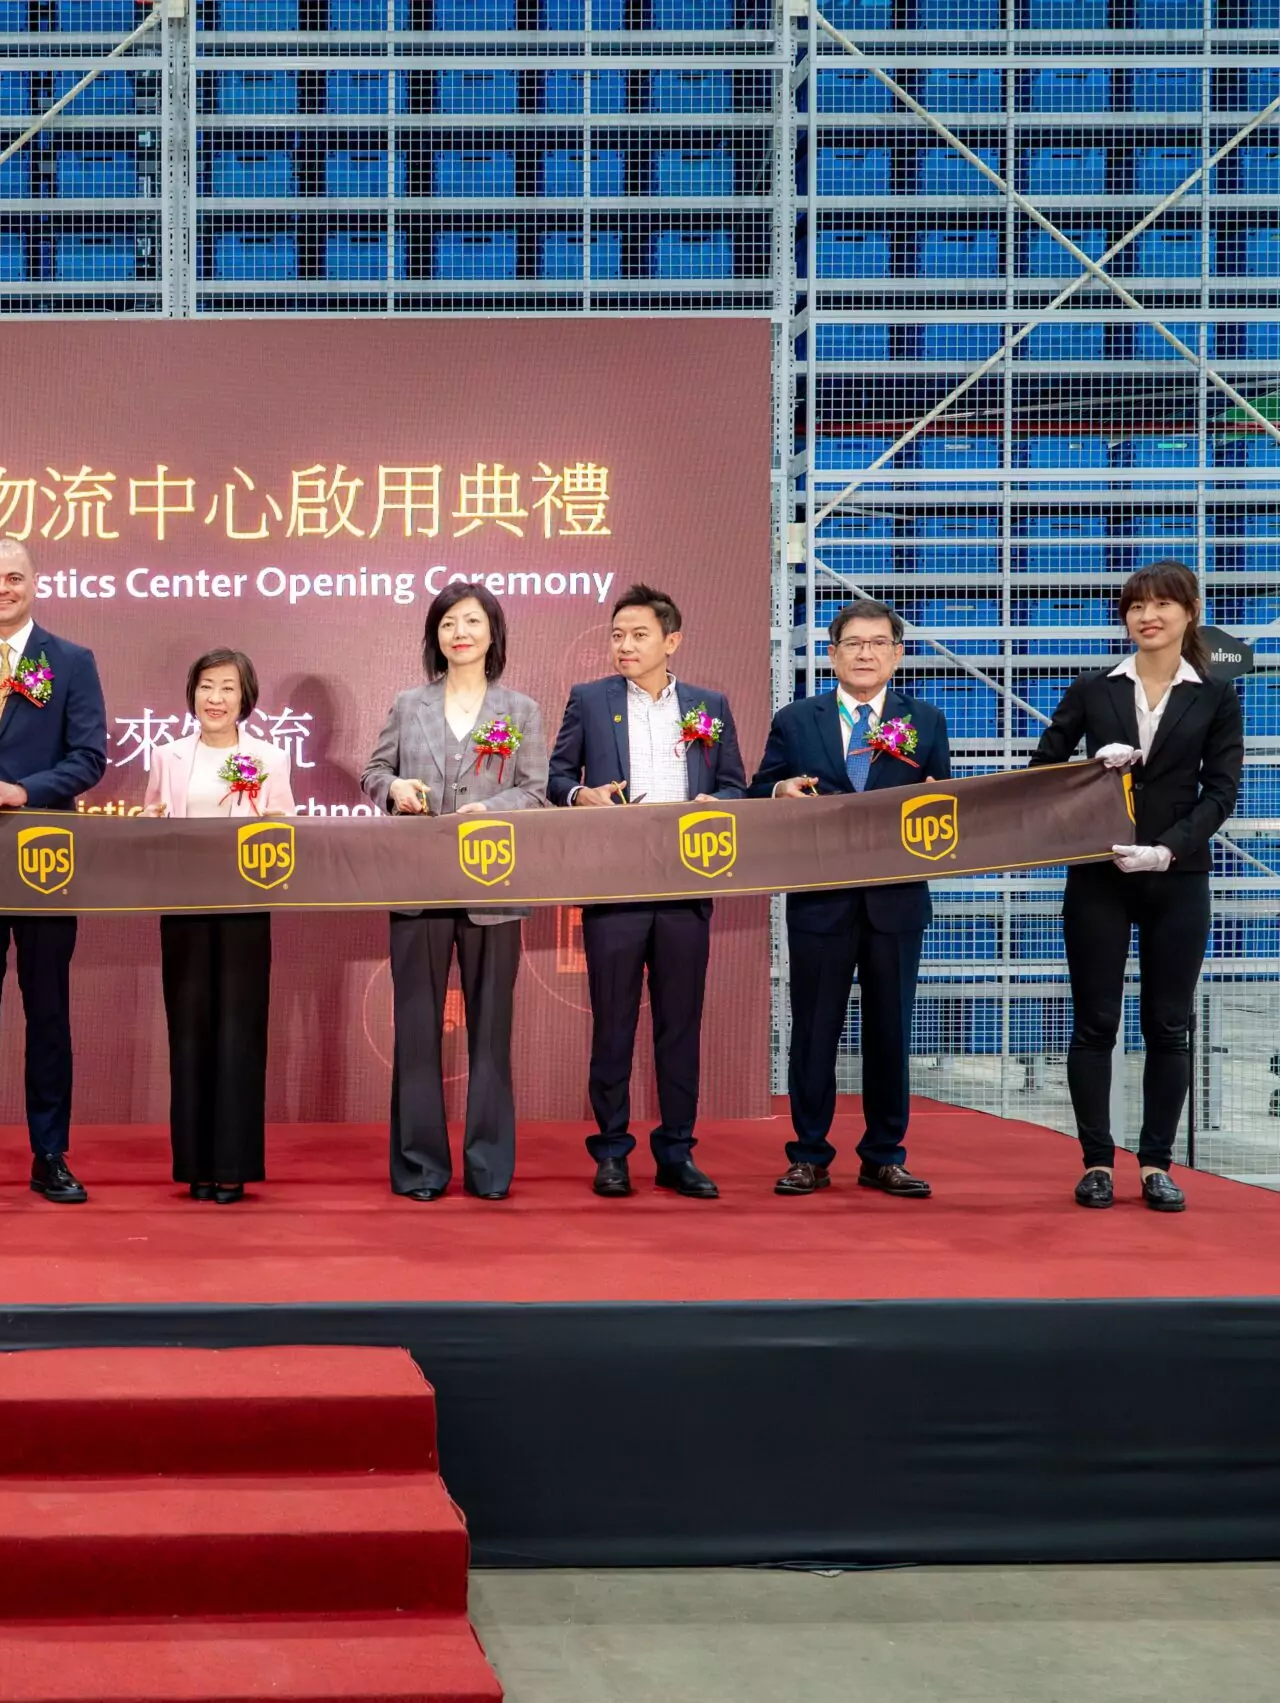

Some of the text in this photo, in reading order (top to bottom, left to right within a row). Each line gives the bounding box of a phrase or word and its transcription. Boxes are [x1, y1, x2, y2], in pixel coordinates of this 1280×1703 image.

[126, 567, 248, 600] Center
[256, 566, 416, 604] Opening
[684, 831, 732, 868] ups
[906, 814, 954, 851] ups
[22, 848, 70, 883] ups
[242, 842, 290, 878] ups
[463, 838, 511, 874] ups
